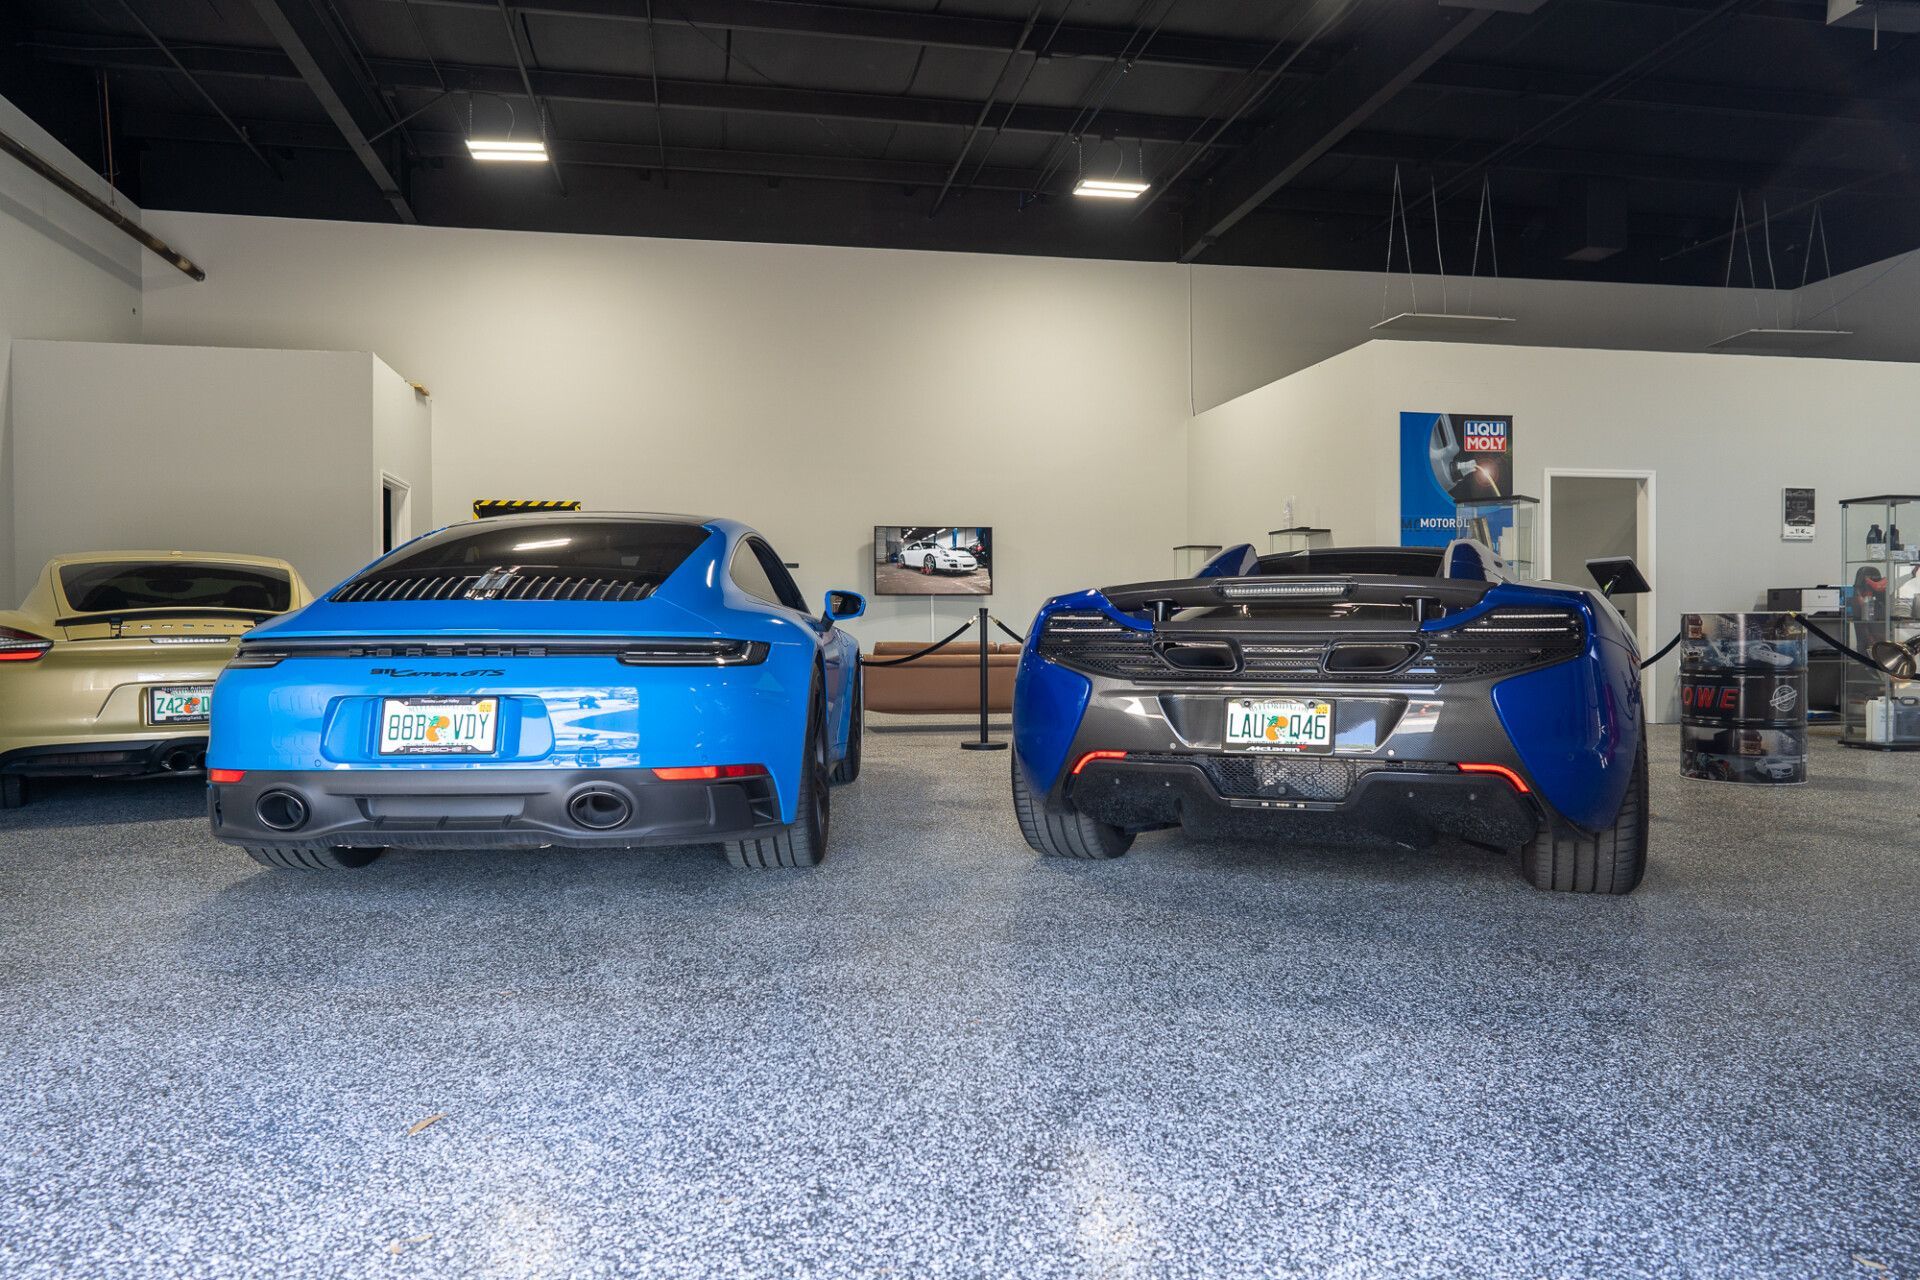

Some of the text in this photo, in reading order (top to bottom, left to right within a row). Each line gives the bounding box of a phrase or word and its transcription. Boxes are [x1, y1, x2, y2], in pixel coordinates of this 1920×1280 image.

[1467, 422, 1505, 436] LIQUI
[1467, 437, 1505, 450] MOLY
[1420, 516, 1470, 528] MOTORÖL
[349, 647, 546, 657] PORSCHE
[391, 669, 458, 678] Carrera
[461, 669, 506, 677] GTS
[1681, 685, 1739, 708] OWE
[156, 698, 184, 714] Z42
[388, 714, 489, 740] 88B VDY
[1229, 713, 1326, 739] LAU Q46
